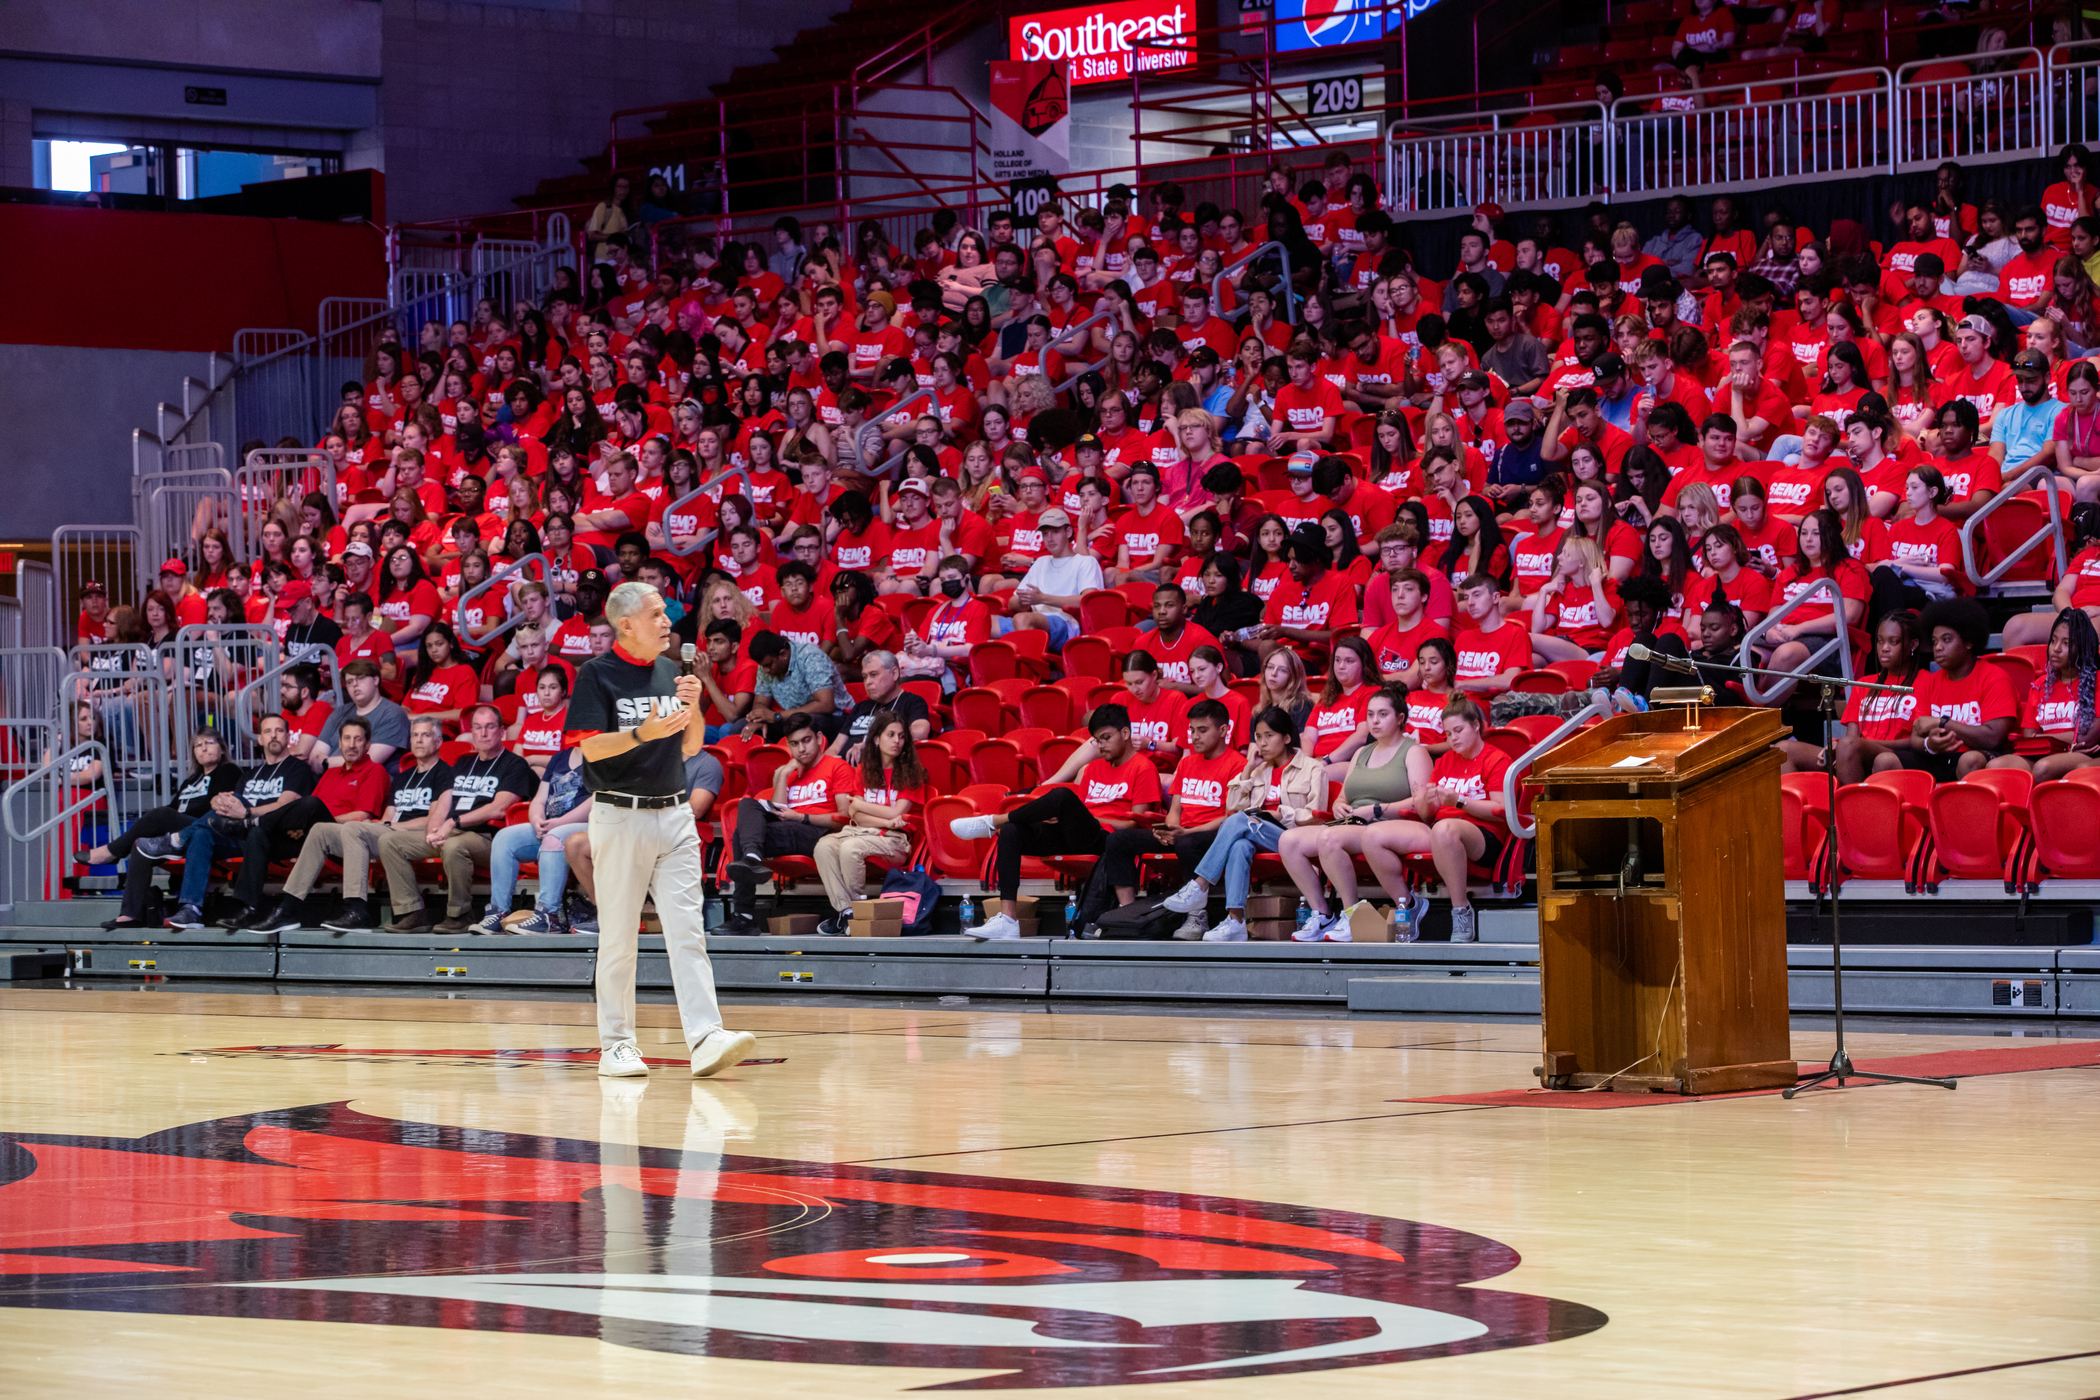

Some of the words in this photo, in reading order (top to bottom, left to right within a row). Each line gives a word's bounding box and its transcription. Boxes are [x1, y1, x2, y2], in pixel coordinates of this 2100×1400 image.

[1021, 4, 1187, 62] Southeast
[1083, 57, 1118, 78] State
[1313, 78, 1360, 113] 209
[994, 160, 1023, 168] COLLEGE
[1012, 170, 1027, 178] AND
[2046, 203, 2079, 221] SEM
[1338, 228, 1364, 241] SEM
[1892, 253, 1915, 268] SEM
[2009, 275, 2046, 292] SEMO
[1015, 363, 1041, 375] SEM
[1425, 372, 1442, 386] SE
[820, 406, 843, 419] SEM
[1287, 406, 1325, 423] SEMO
[1152, 447, 1179, 461] SEM
[1769, 482, 1812, 500] SEMO
[670, 515, 697, 530] EMO
[1428, 519, 1455, 533] SEM
[719, 554, 741, 570] SE
[838, 546, 871, 562] SEMO
[892, 548, 926, 563] SEMO
[1516, 553, 1553, 568] SEMO
[1282, 602, 1330, 622] SEMO
[1383, 660, 1408, 671] SEMO
[1457, 651, 1500, 670] SEMO
[616, 695, 682, 720] SEMO
[2036, 702, 2077, 720] SEM
[1130, 721, 1169, 739] EMO
[454, 776, 499, 791] SEMO
[1182, 778, 1223, 796] SEMO
